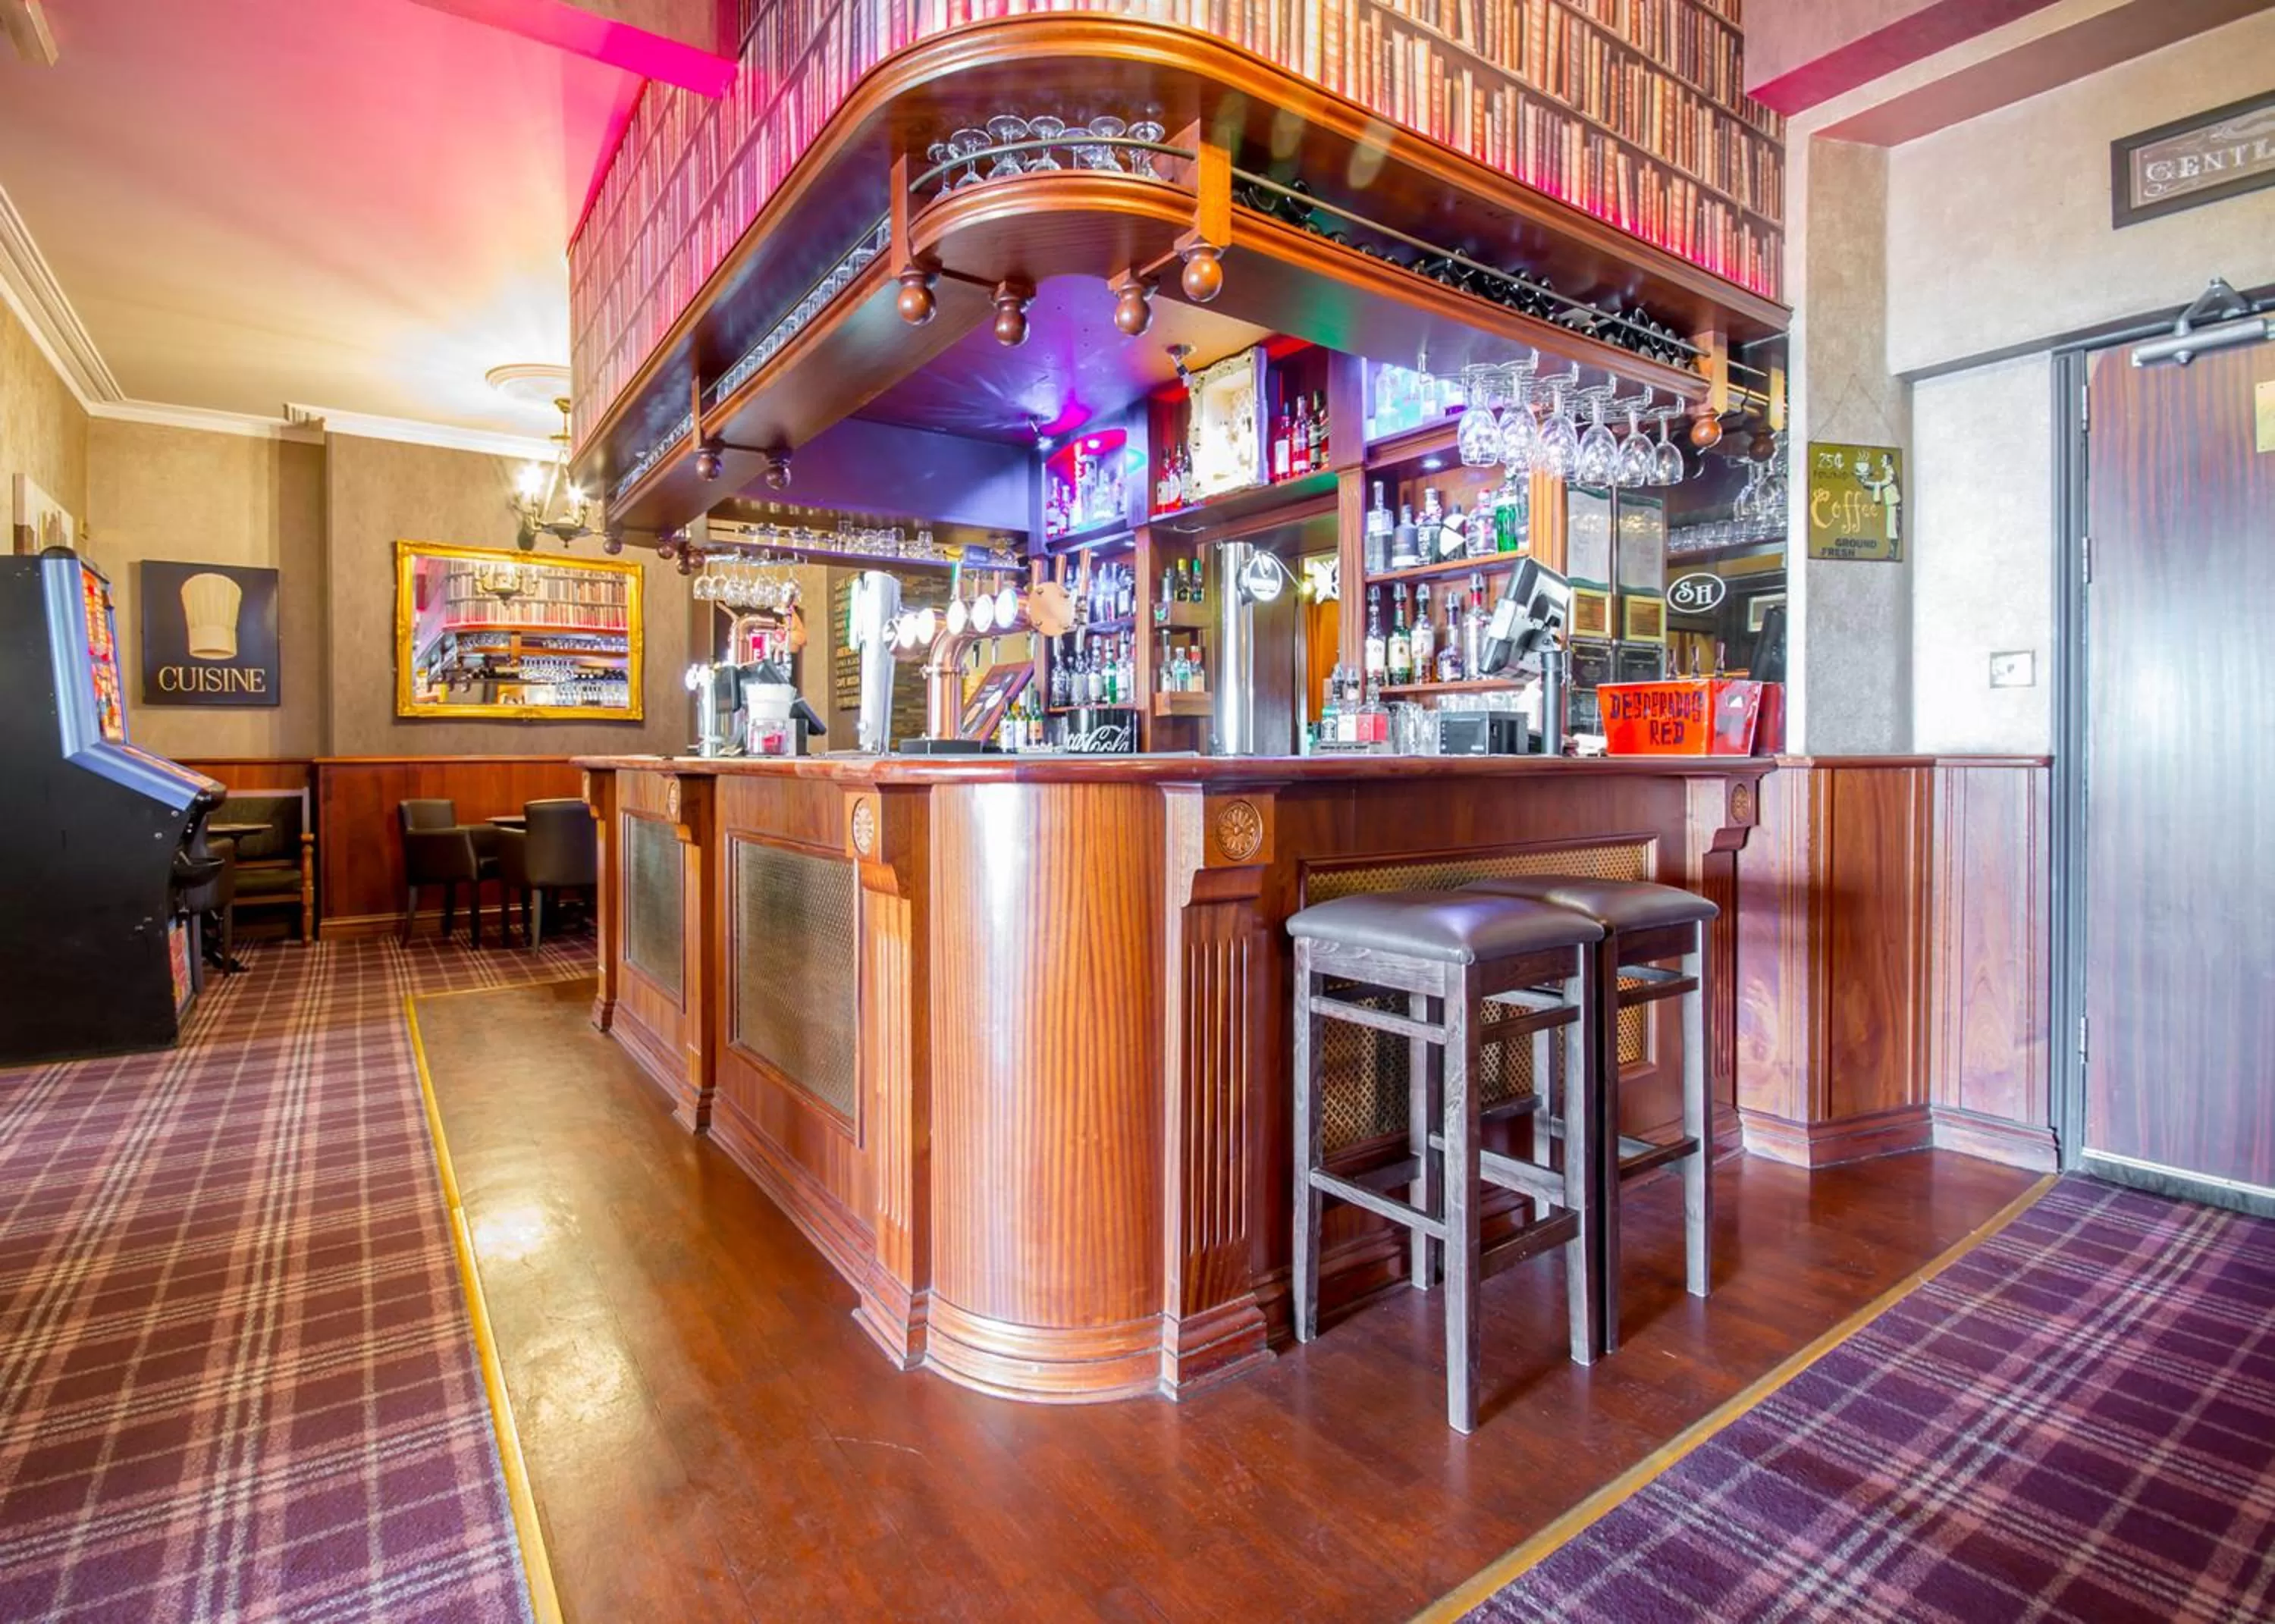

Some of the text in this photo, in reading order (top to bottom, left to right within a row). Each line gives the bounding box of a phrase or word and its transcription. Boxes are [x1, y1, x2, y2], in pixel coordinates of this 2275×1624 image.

[1810, 488, 1878, 535] Coffee
[1820, 547, 1856, 557] FRESH
[1834, 538, 1878, 548] GROUND
[1674, 580, 1715, 606] SH
[158, 666, 266, 693] CUISINE
[1609, 690, 1704, 723] DESPERADOS
[1649, 720, 1685, 746] RED
